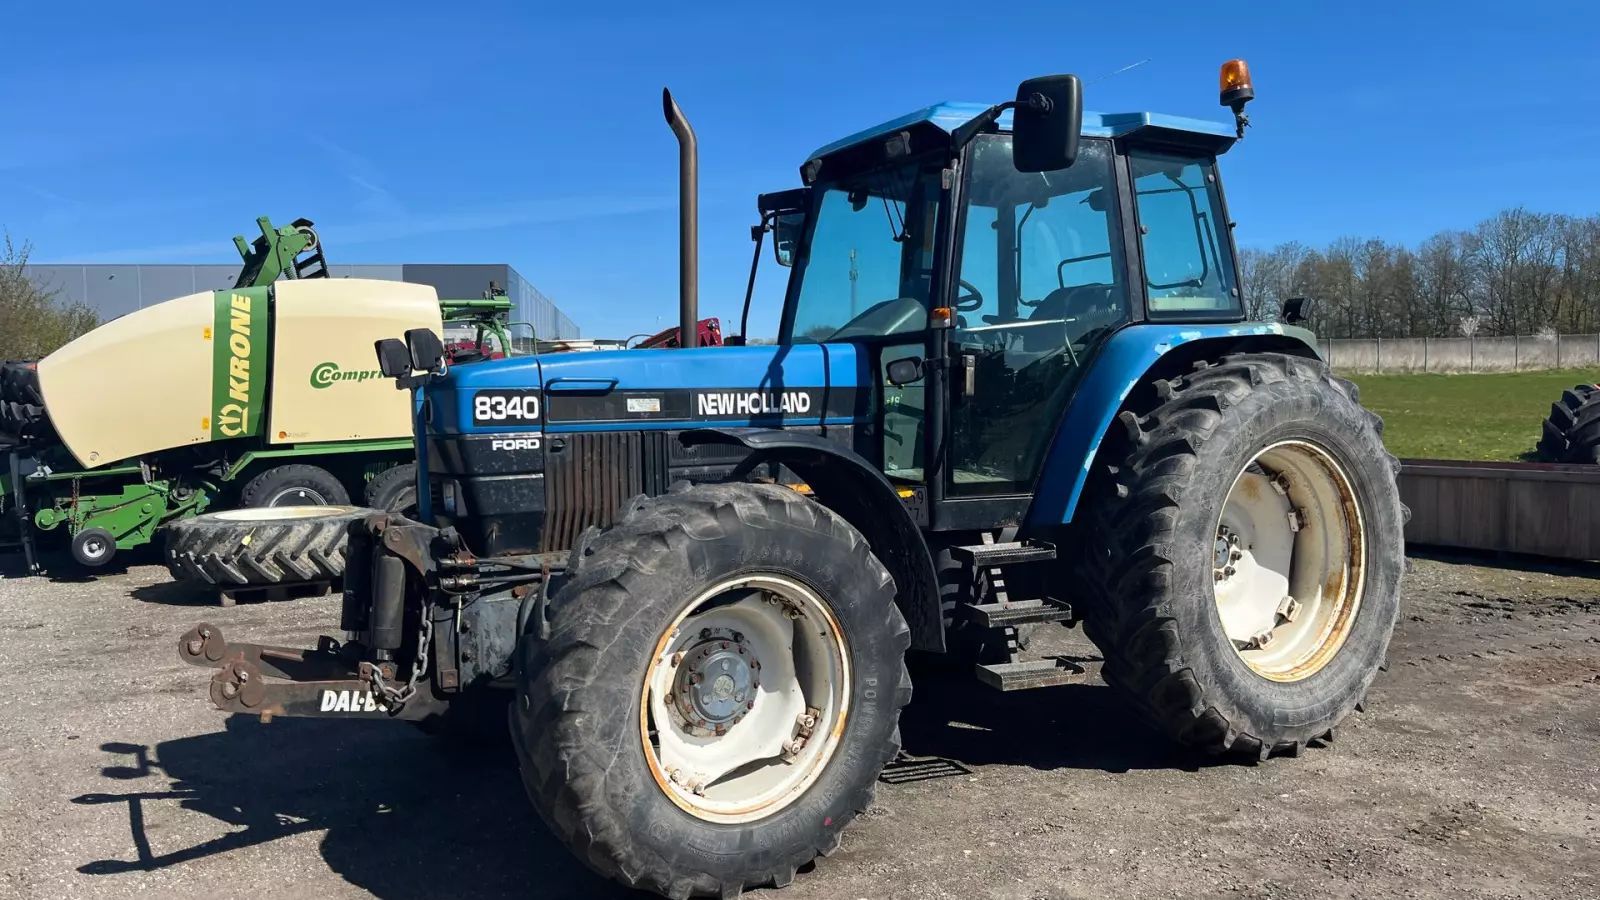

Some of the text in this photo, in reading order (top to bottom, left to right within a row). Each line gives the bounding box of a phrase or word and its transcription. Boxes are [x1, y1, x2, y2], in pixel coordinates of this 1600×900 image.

[229, 293, 251, 403] KRONE
[475, 396, 539, 420] 8340
[698, 392, 810, 415] NEW HOLLAND
[492, 439, 540, 451] FORD
